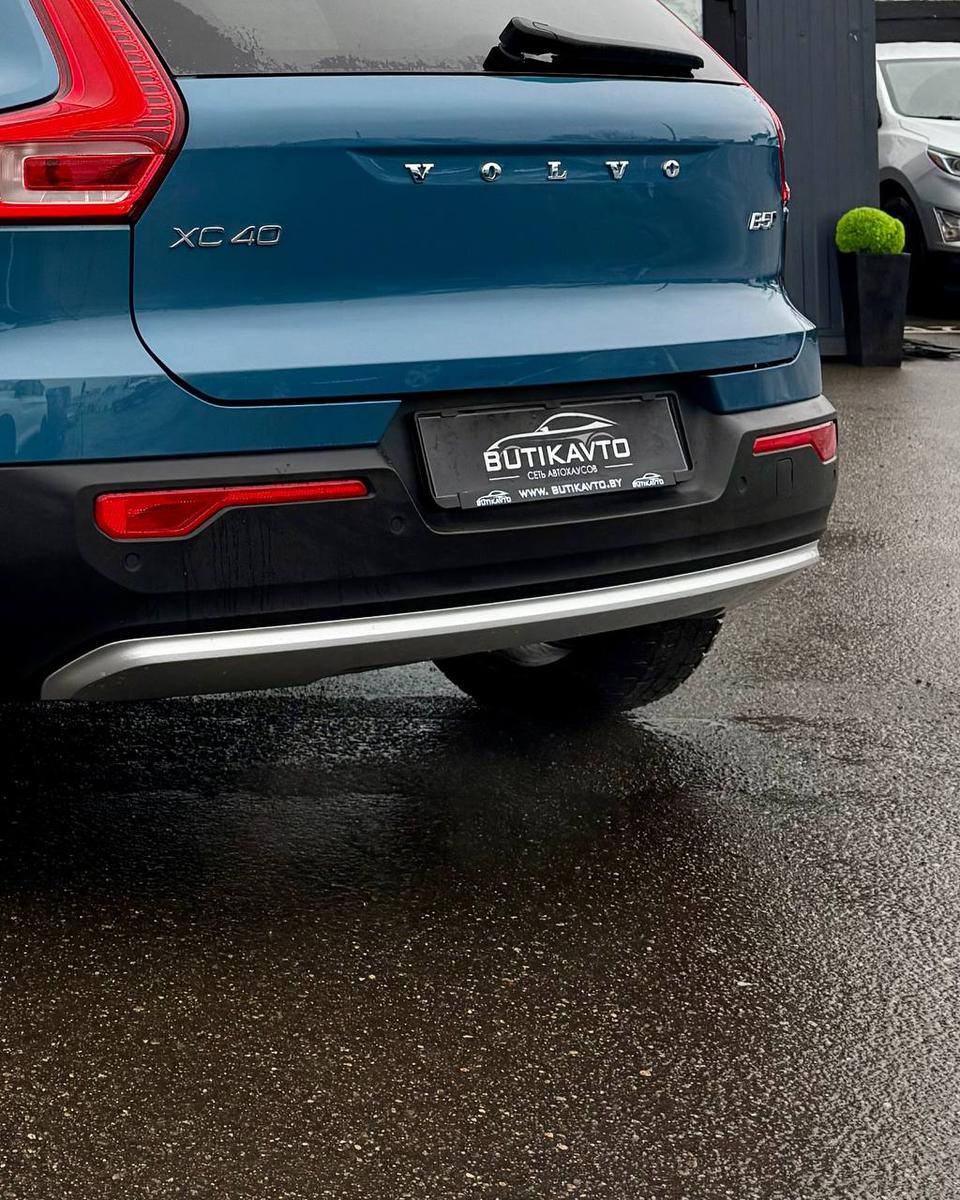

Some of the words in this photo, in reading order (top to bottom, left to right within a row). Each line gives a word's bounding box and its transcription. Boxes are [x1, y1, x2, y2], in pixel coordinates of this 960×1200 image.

[405, 159, 680, 183] VOLVO
[483, 438, 631, 472] BUTIKAVTO
[527, 470, 547, 480] СЕТЬ
[548, 464, 599, 479] АВТОХАУСОВ
[551, 478, 623, 496] BUTIKAVTO.BY
